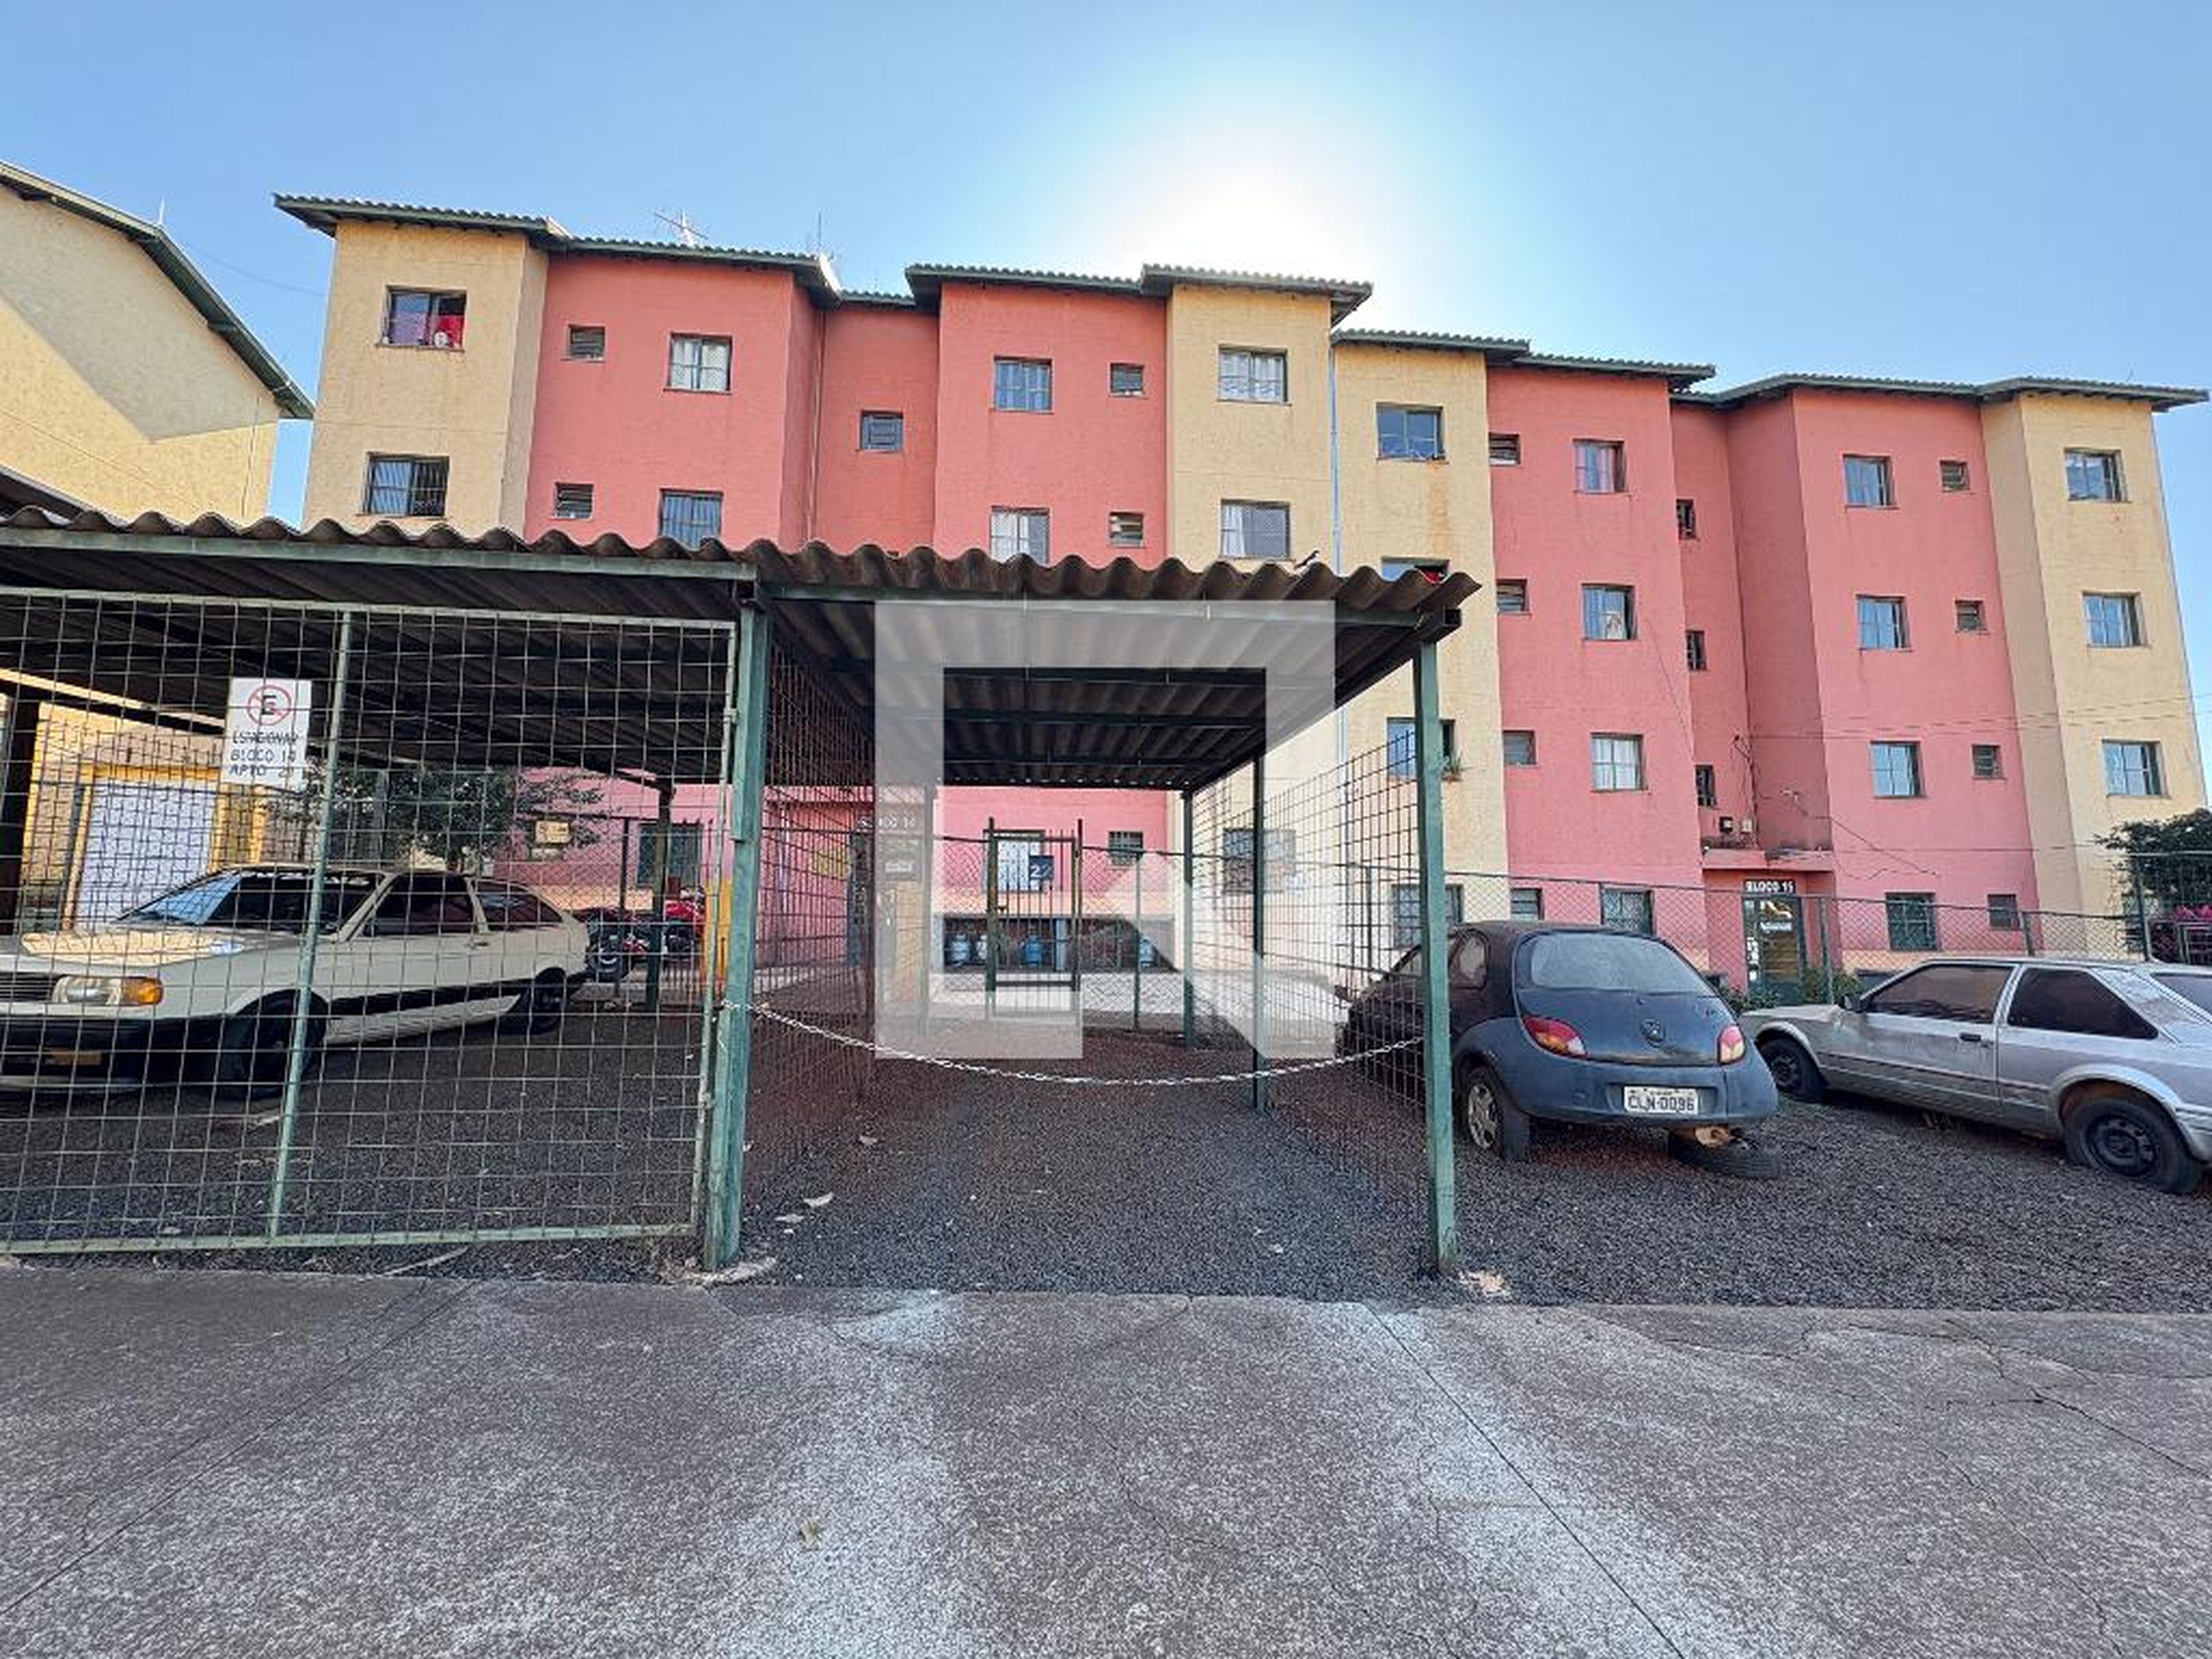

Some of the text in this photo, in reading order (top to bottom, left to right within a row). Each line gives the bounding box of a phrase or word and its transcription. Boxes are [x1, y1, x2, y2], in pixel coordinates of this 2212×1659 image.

[261, 695, 276, 715] E
[230, 748, 275, 763] BLOCO
[229, 764, 267, 777] APTO
[1745, 880, 1780, 893] BLOCO
